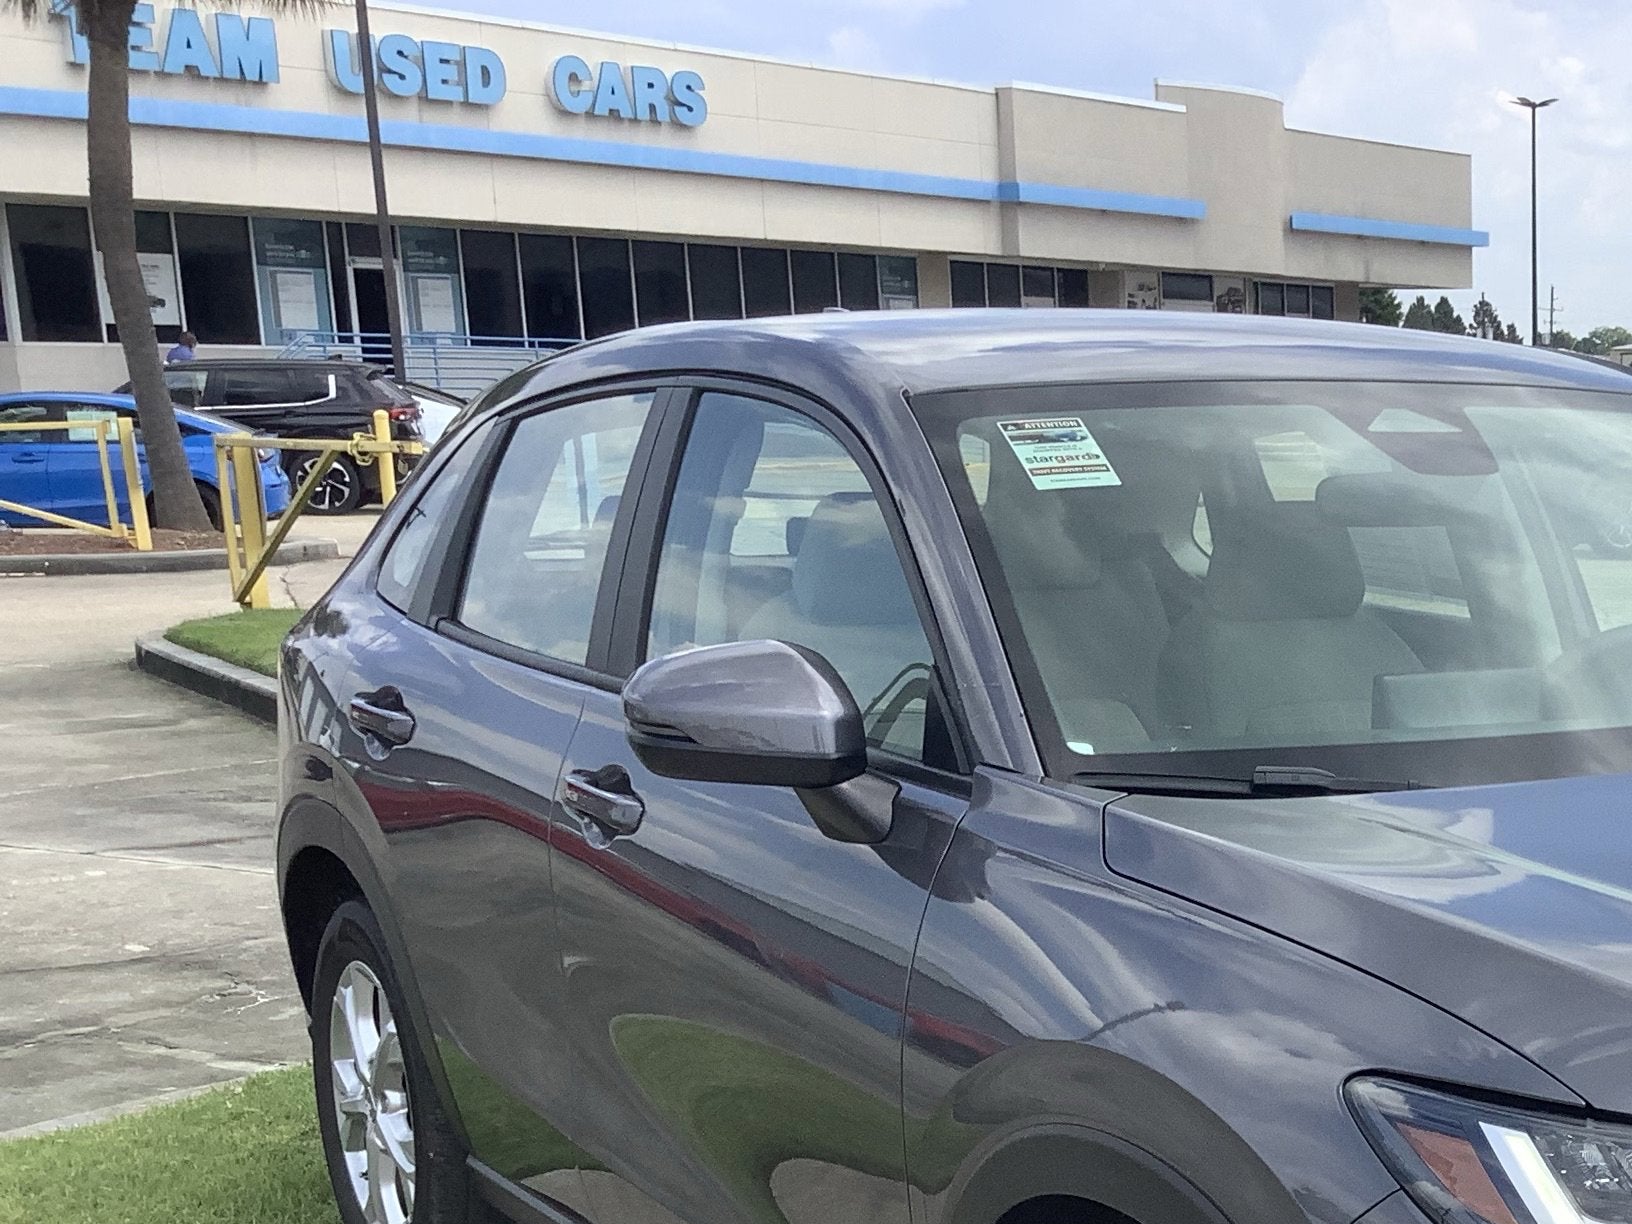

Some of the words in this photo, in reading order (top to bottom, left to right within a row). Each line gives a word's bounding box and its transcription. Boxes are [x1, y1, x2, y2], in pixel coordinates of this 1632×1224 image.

[327, 28, 507, 105] USED
[550, 54, 709, 128] CARS
[1024, 420, 1078, 430] ATTENTION
